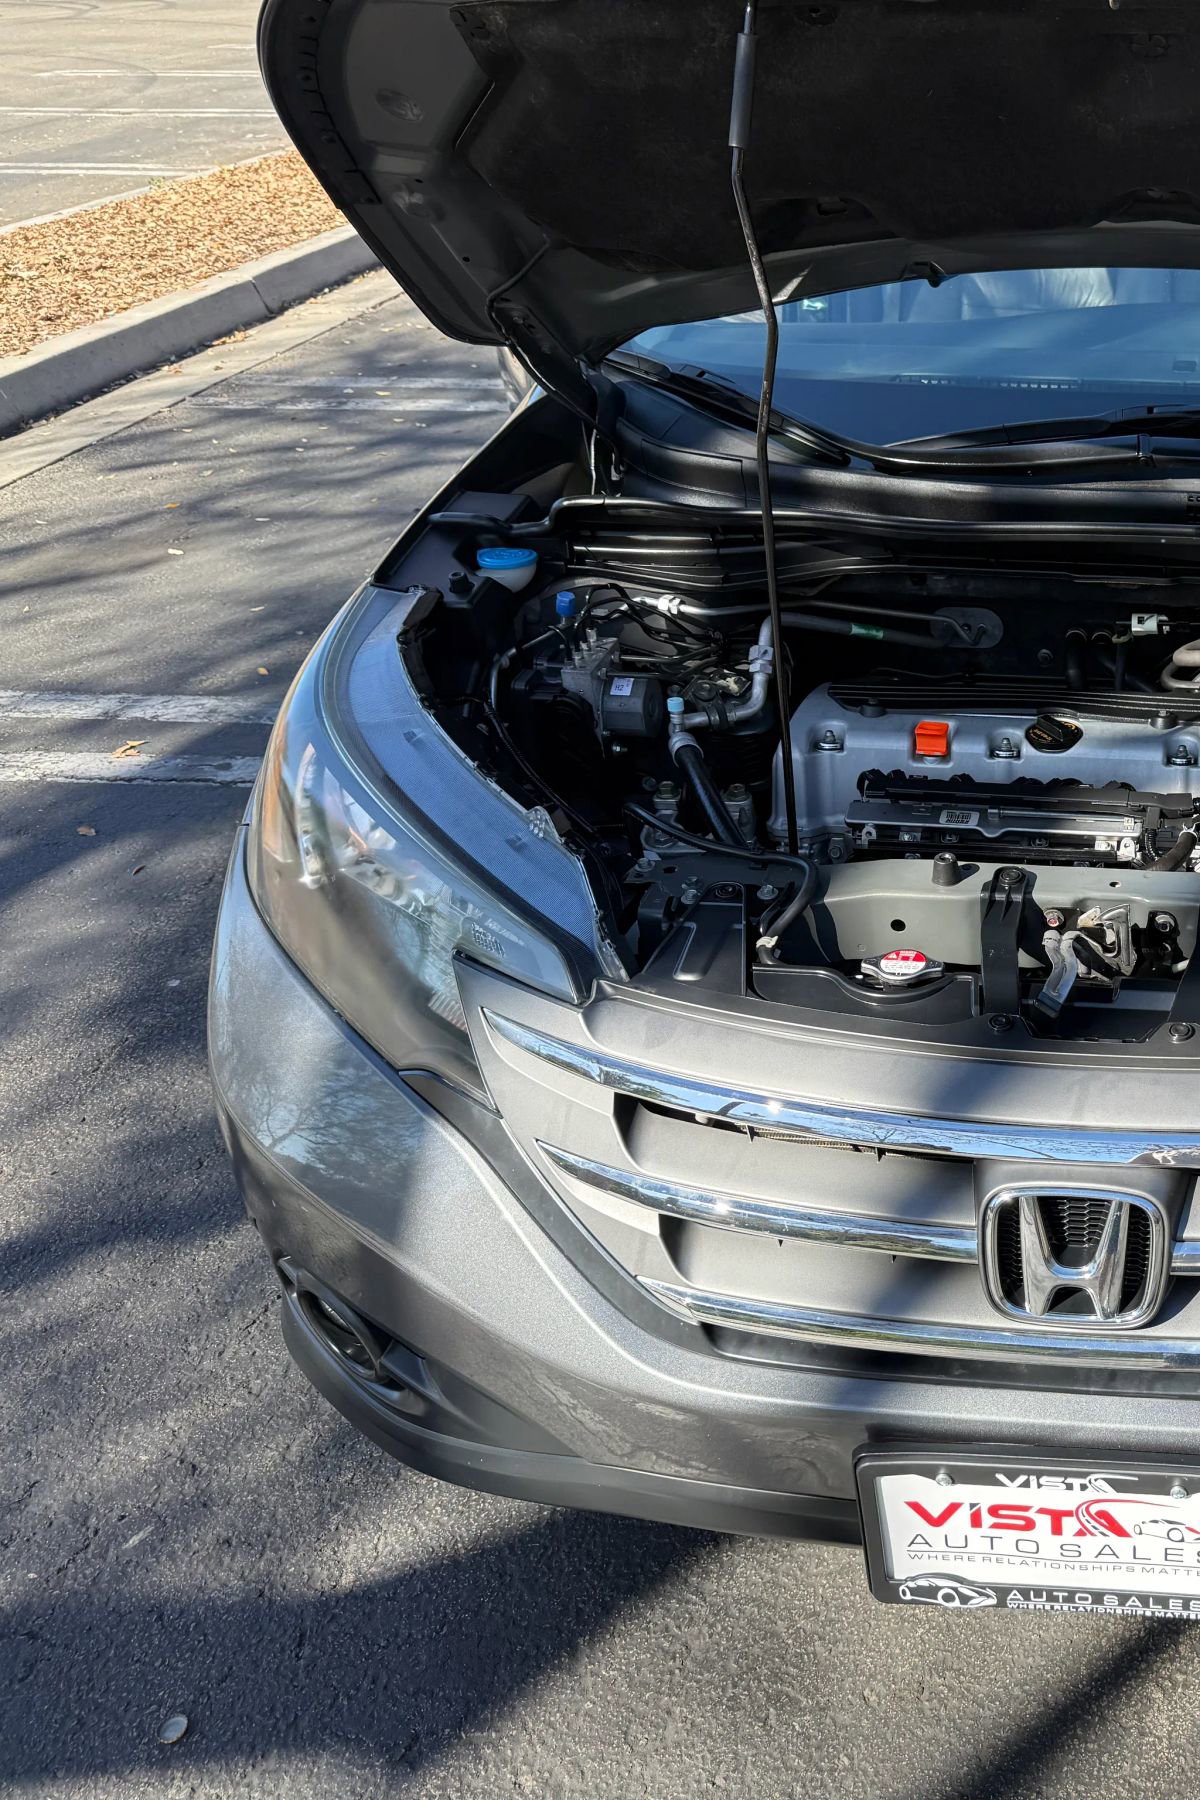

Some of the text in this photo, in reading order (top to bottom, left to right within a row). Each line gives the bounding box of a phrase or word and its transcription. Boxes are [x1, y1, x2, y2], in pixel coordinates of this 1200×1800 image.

[995, 1473, 1120, 1494] VISTA
[904, 1499, 1134, 1538] VISTA
[907, 1533, 1040, 1554] AUTO
[908, 1552, 976, 1563] WHERE
[982, 1555, 1135, 1574] RELATIONSHIPS
[1006, 1589, 1092, 1605] AUTO
